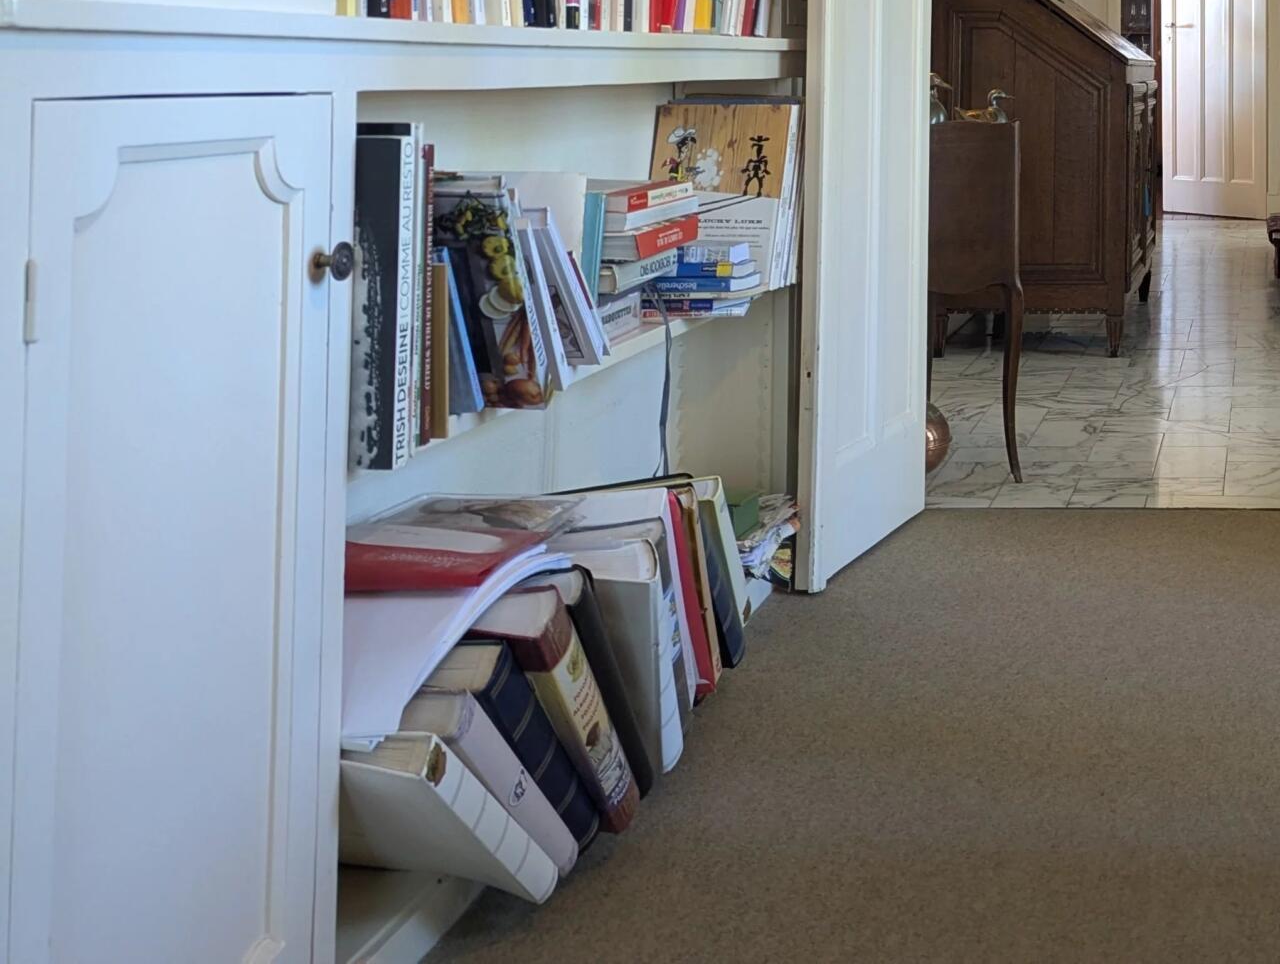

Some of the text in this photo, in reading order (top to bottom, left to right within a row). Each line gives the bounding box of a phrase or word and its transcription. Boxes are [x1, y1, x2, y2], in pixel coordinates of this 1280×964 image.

[395, 141, 414, 464] TRISH DESEINE COMME AU RESTO
[656, 282, 697, 290] Bescherelle
